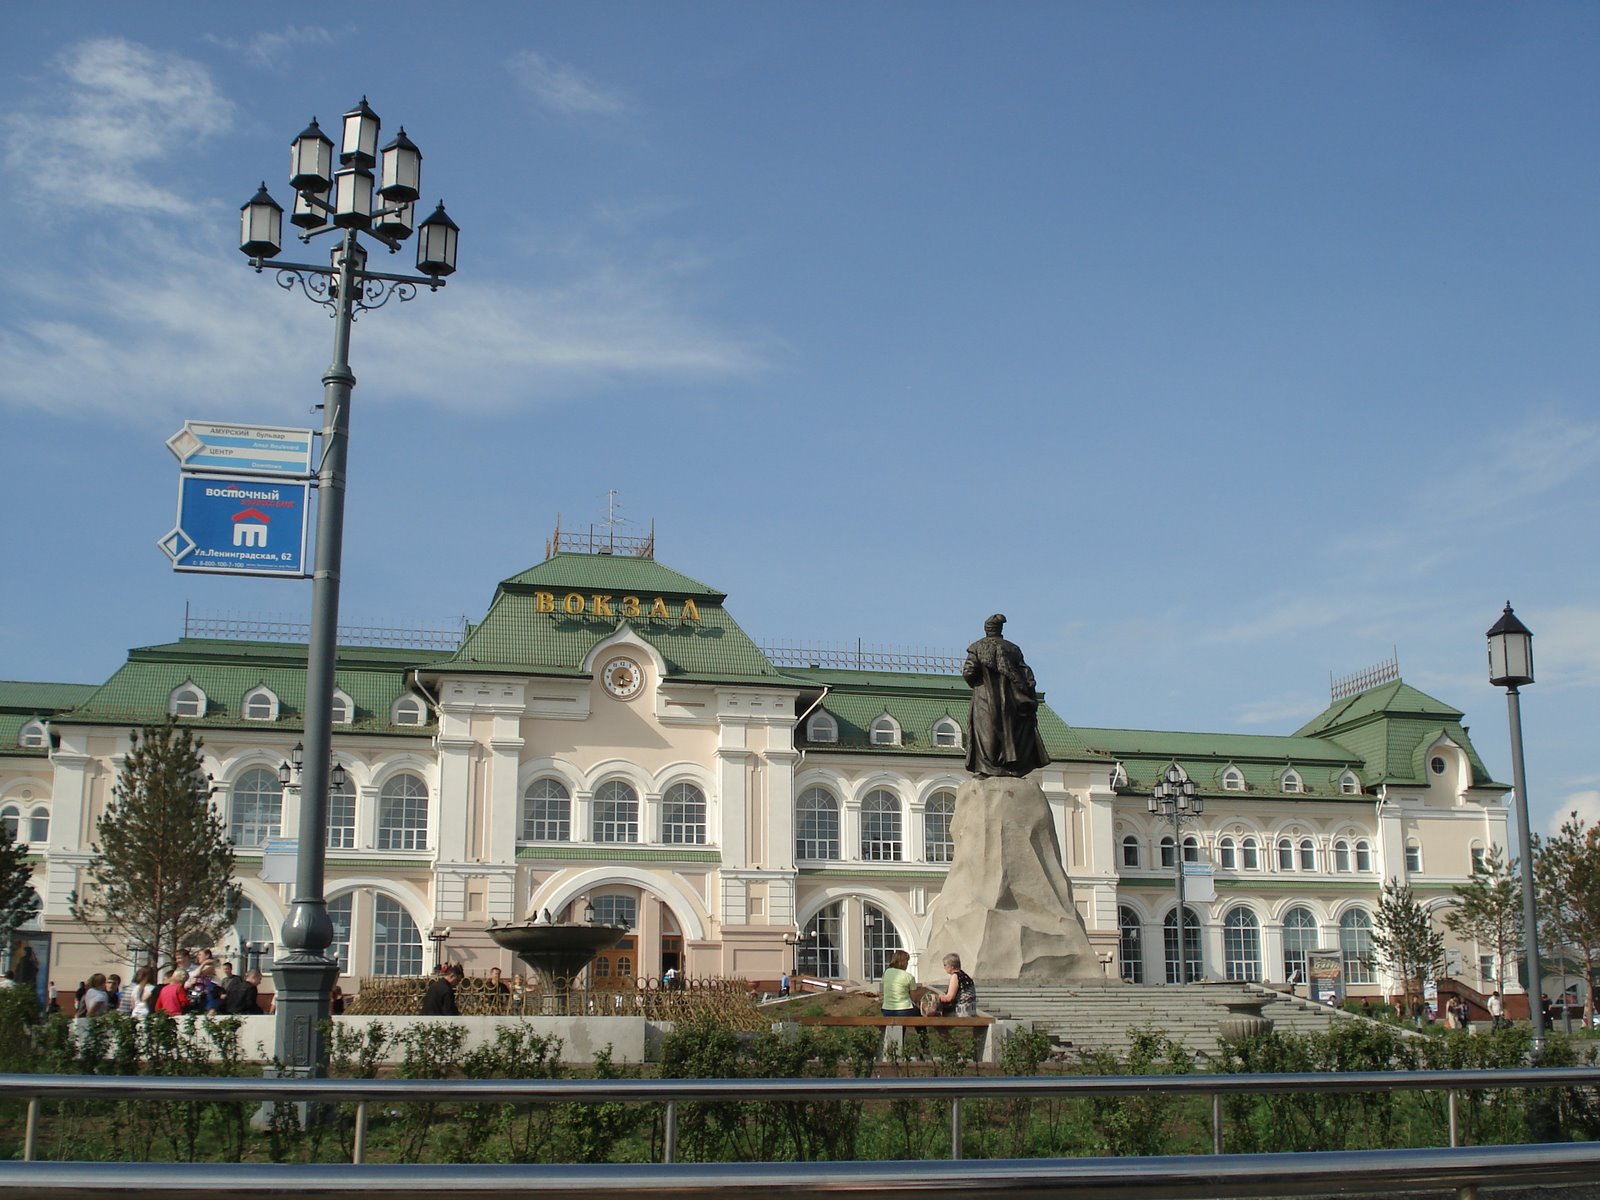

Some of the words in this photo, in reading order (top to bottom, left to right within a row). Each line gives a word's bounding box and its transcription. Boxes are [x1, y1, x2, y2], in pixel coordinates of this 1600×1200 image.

[210, 427, 249, 437] АМУРСКИЙ
[256, 431, 286, 440] бульвар
[209, 448, 234, 456] ЦЕНТР
[281, 552, 292, 561] 62
[534, 591, 700, 621] ВОКЗАЛ
